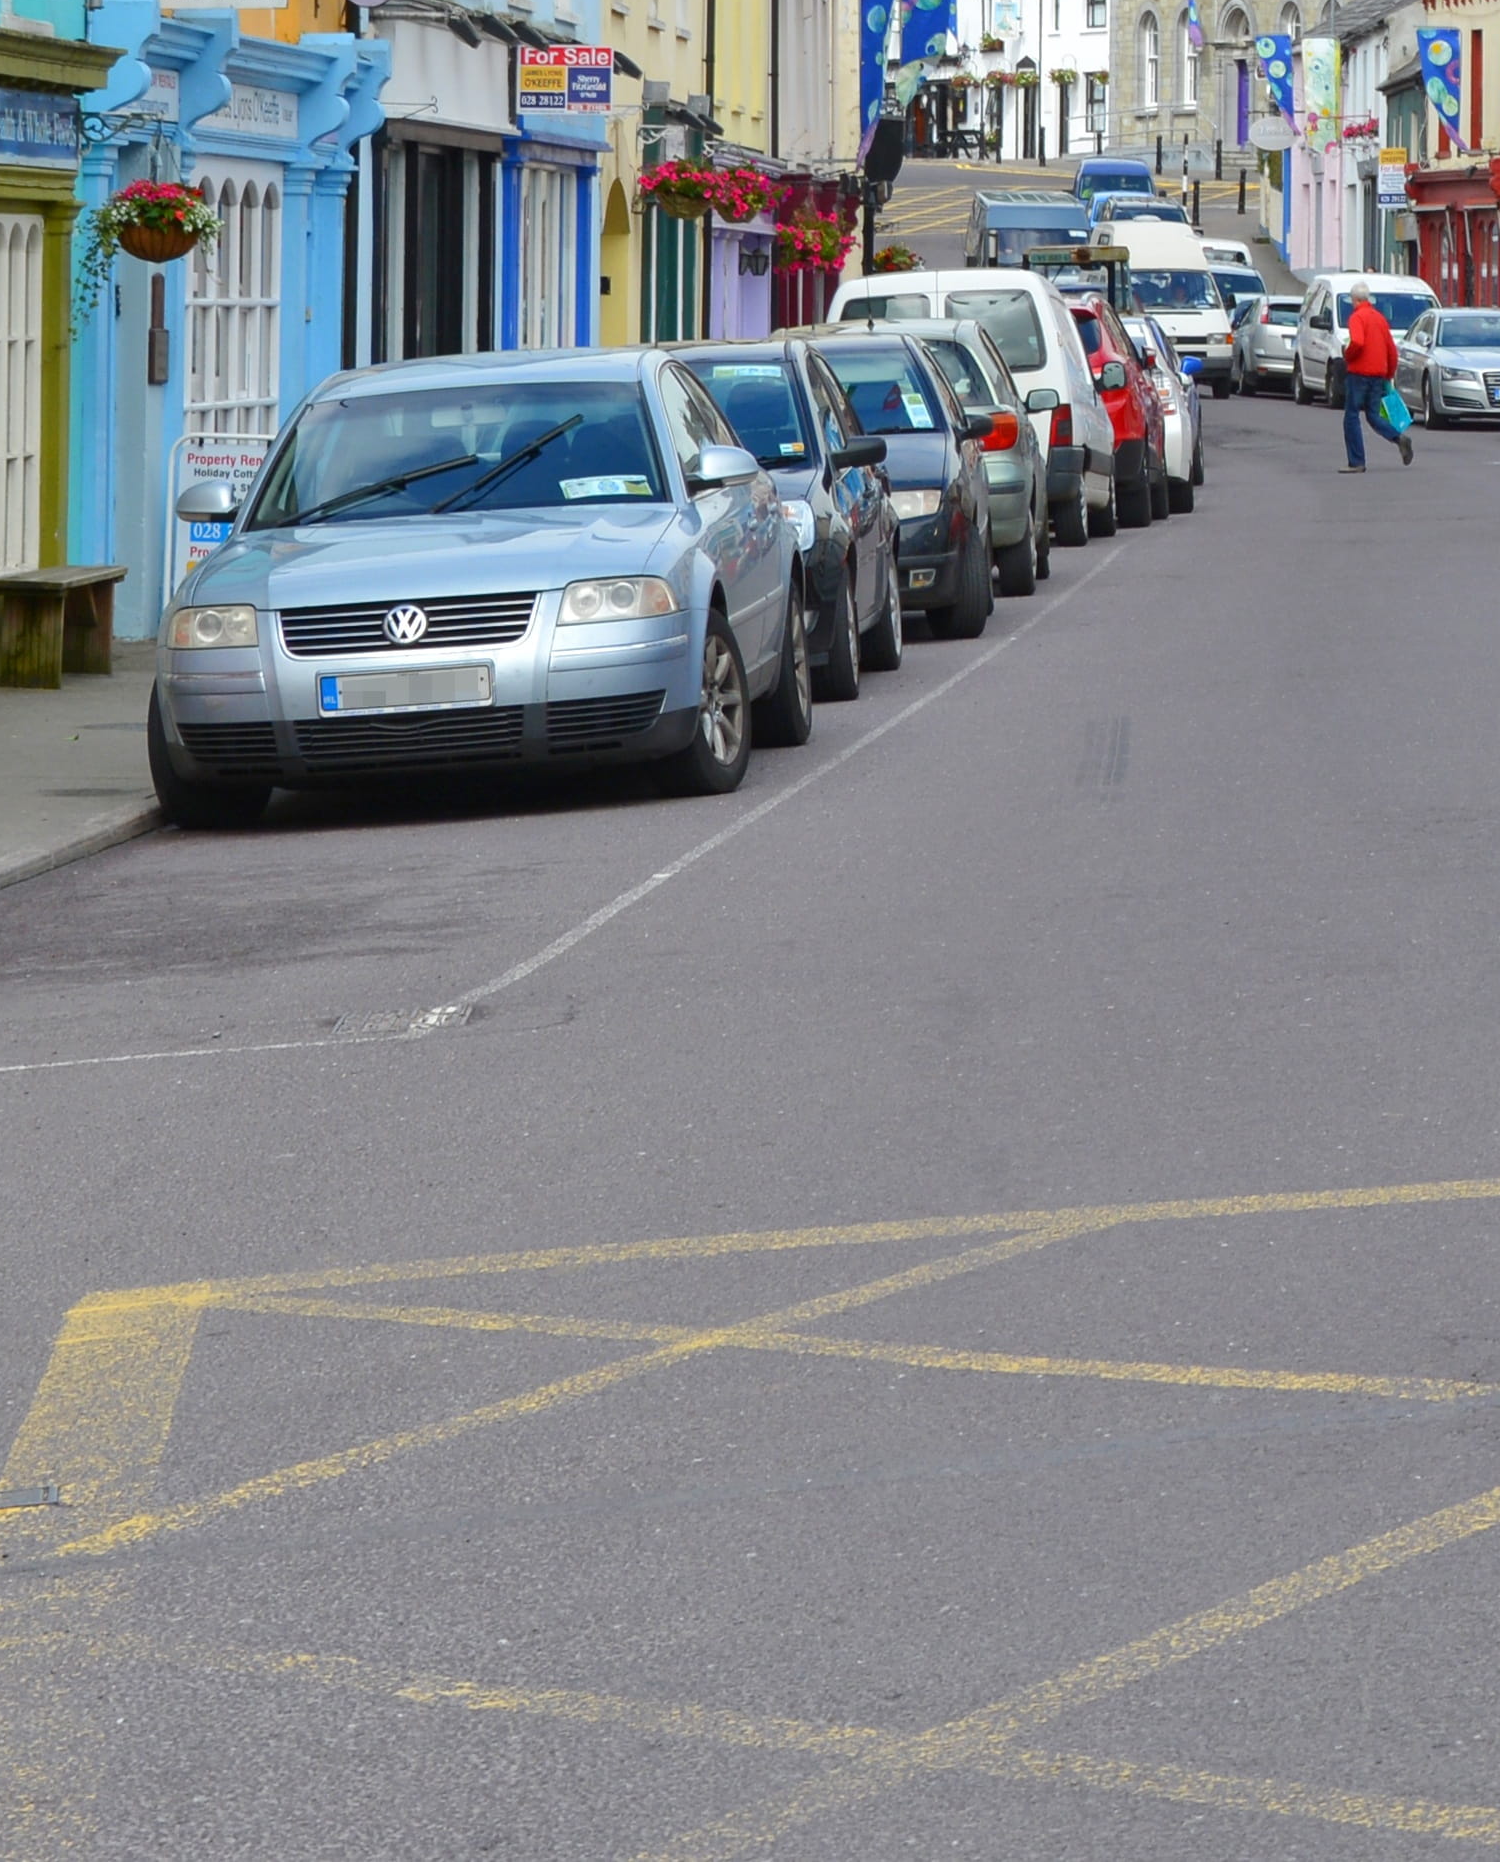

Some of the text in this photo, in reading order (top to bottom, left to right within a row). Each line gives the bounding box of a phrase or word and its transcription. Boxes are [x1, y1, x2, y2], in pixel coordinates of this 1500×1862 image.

[524, 47, 609, 66] For Sale
[524, 78, 562, 88] O'KEEFFE
[521, 95, 563, 106] 028 28122
[187, 453, 236, 467] Property
[194, 468, 230, 480] Holiday
[193, 522, 221, 539] 028
